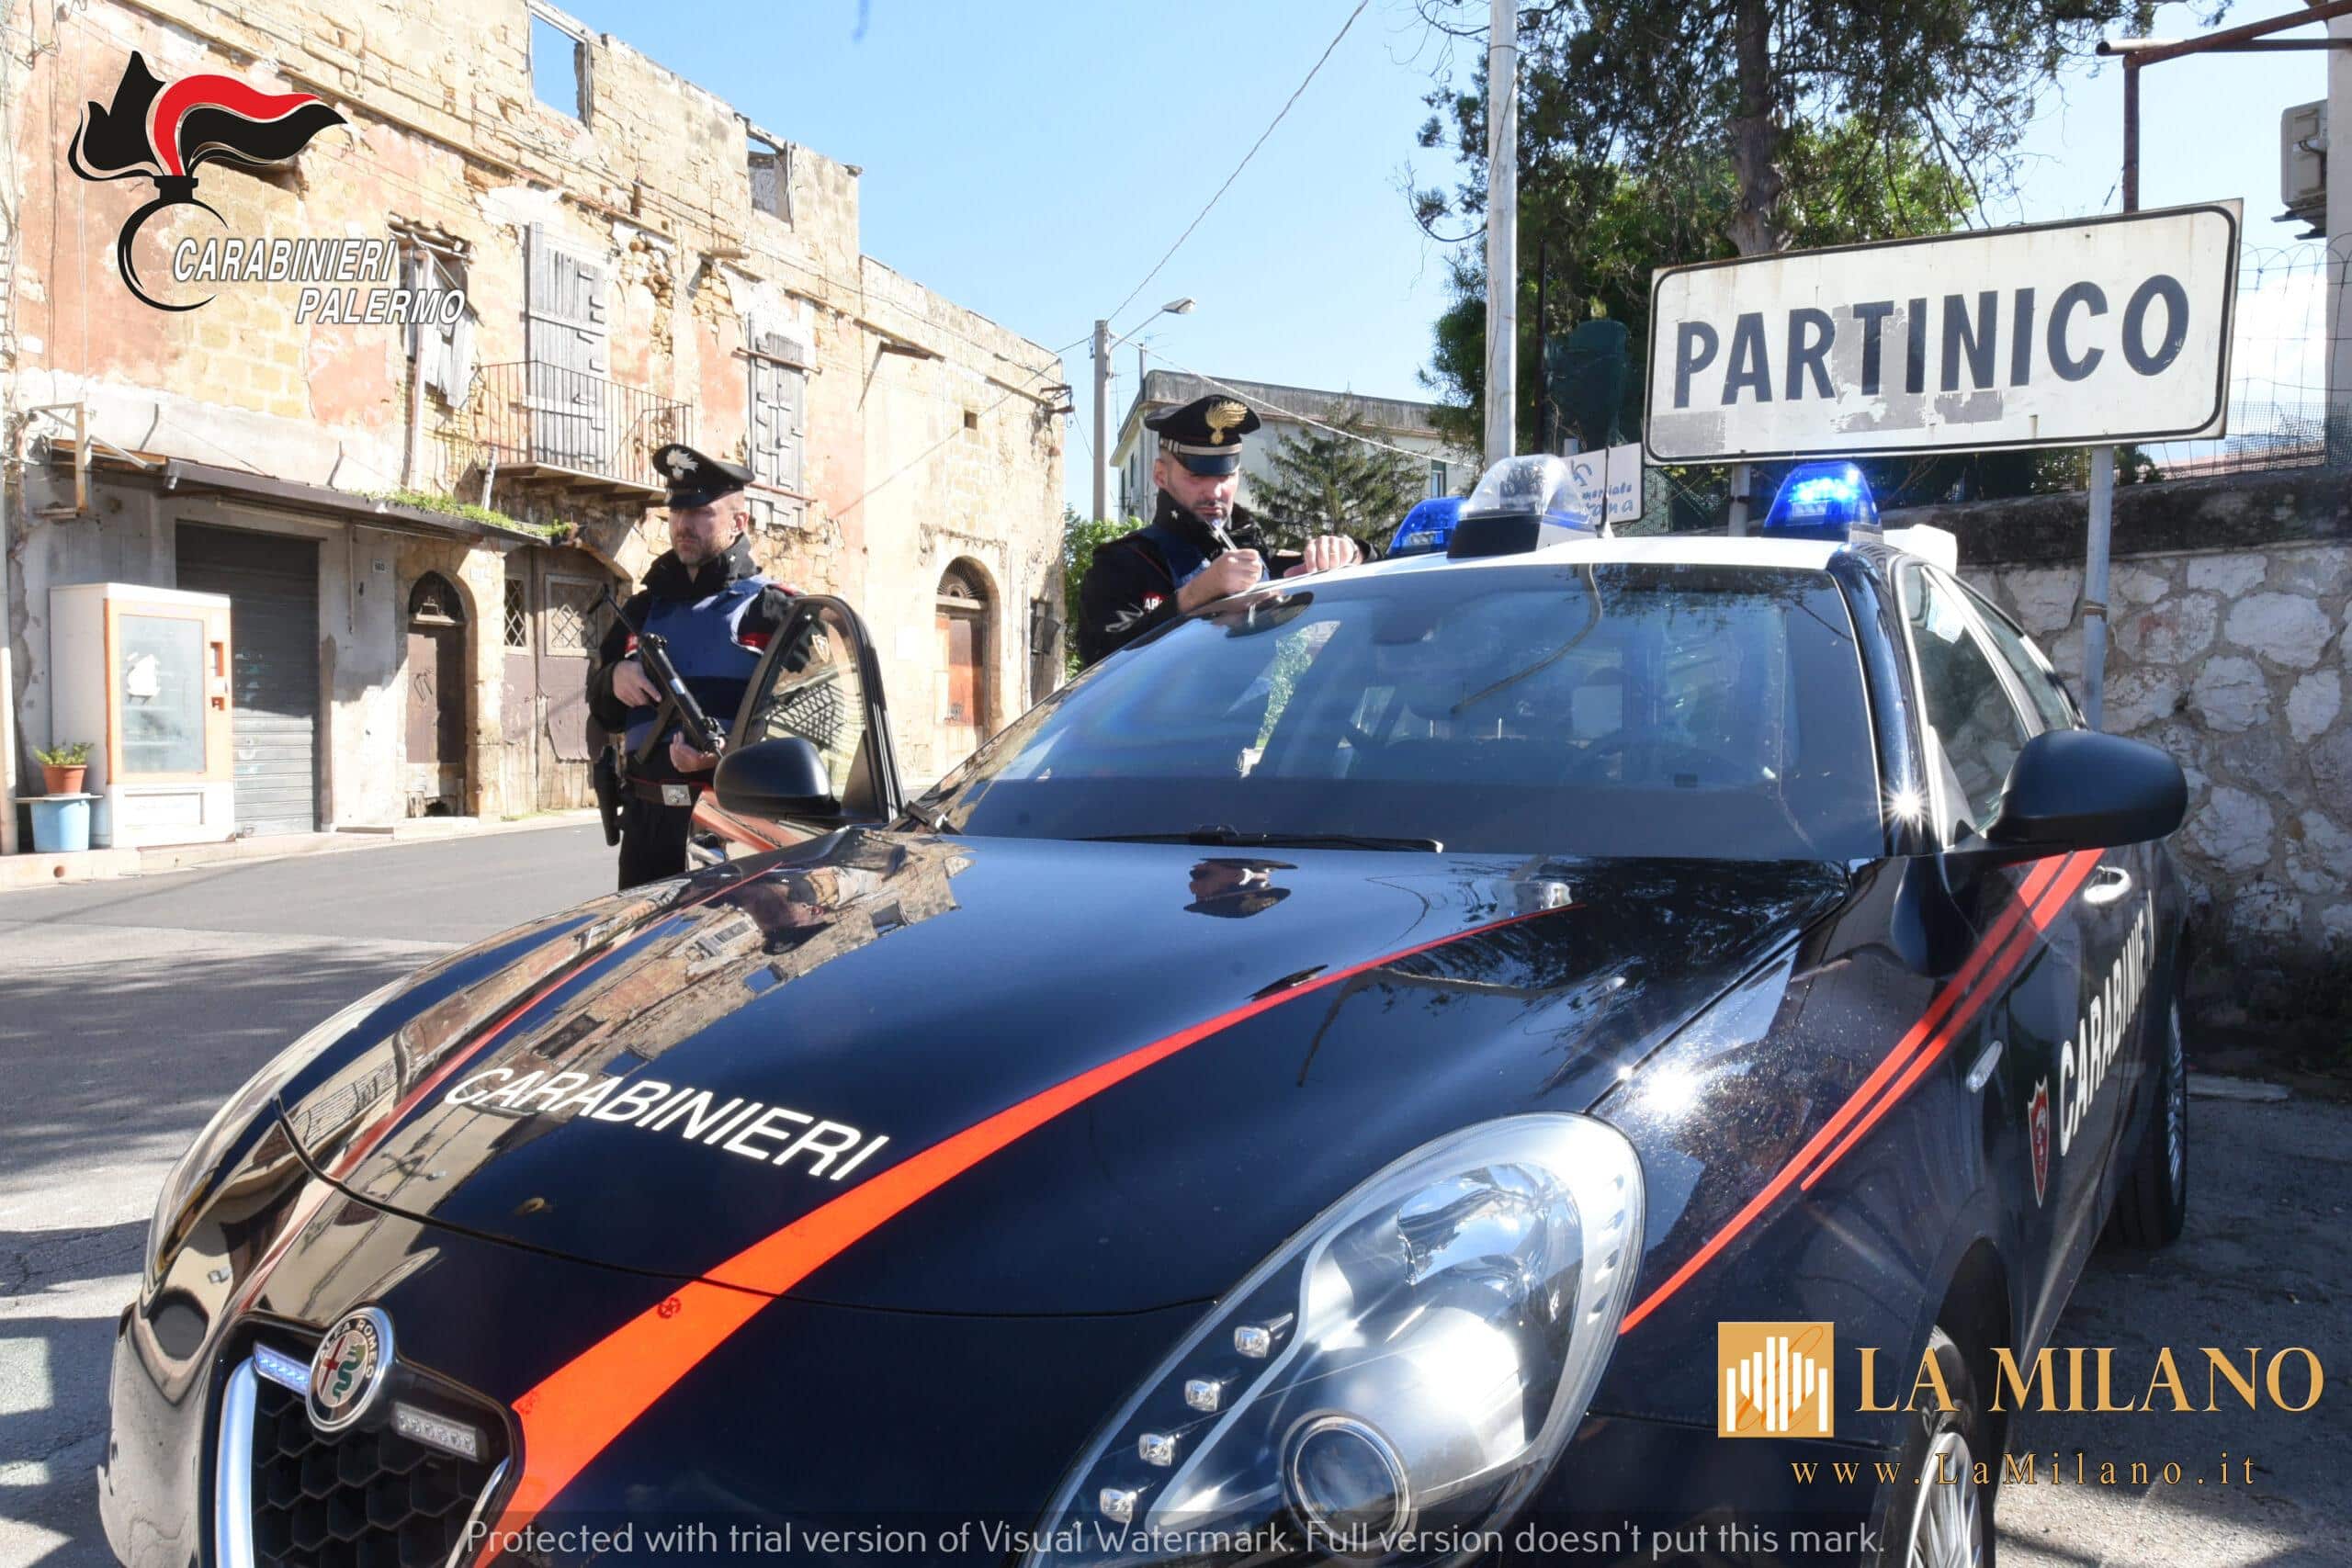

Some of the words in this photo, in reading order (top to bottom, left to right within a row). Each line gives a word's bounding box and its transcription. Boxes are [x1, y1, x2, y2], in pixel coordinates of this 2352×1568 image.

[1673, 274, 2189, 409] PARTINICO
[445, 1067, 890, 1181] CARABINIERI
[356, 1320, 378, 1379] ROMEO
